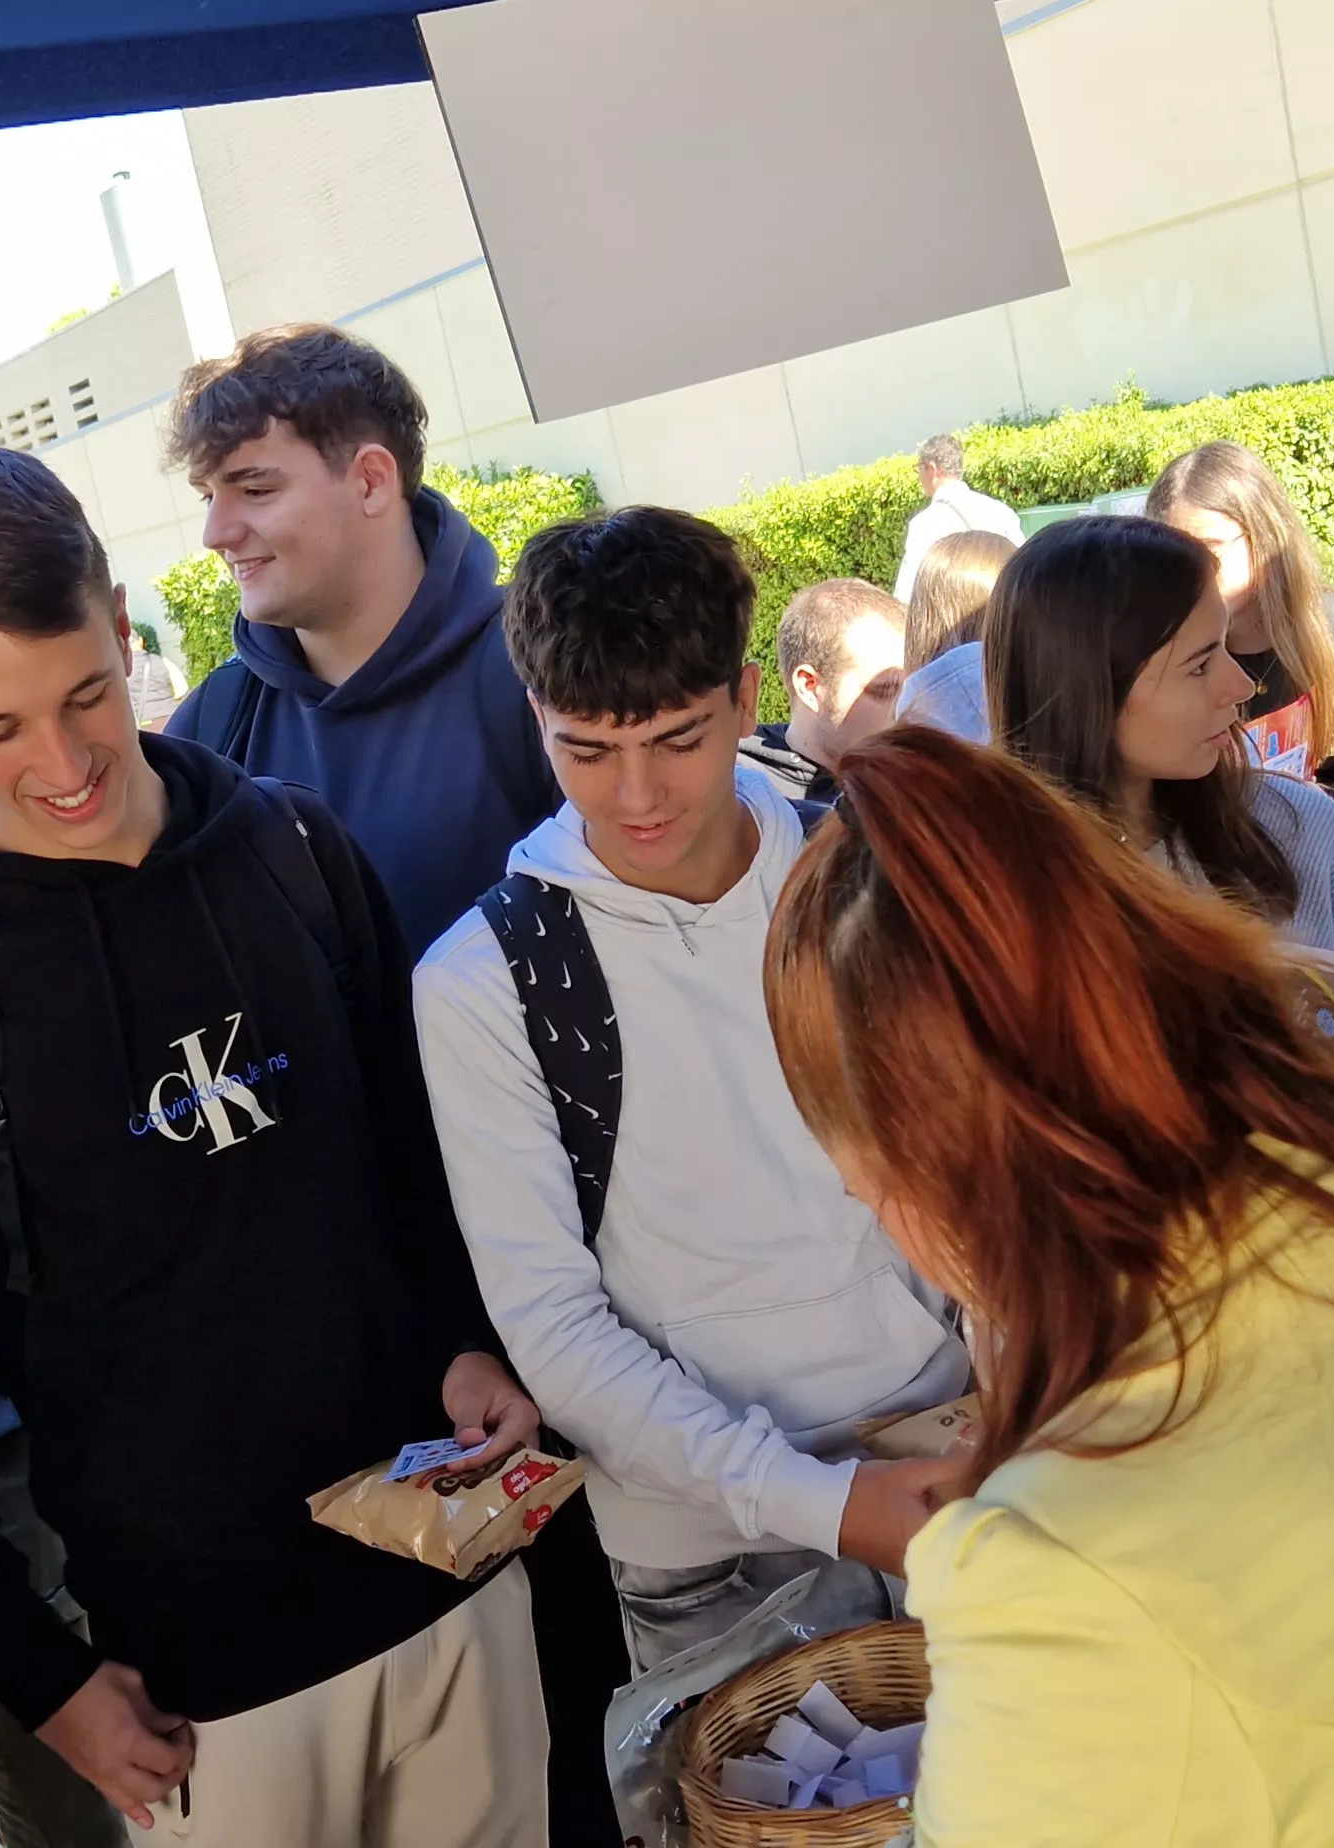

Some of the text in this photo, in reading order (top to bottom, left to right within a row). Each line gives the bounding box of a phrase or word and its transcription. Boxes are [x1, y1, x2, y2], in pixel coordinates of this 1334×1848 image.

[128, 1053, 289, 1136] Calvin Klein Jens
[148, 1011, 277, 1156] CK
